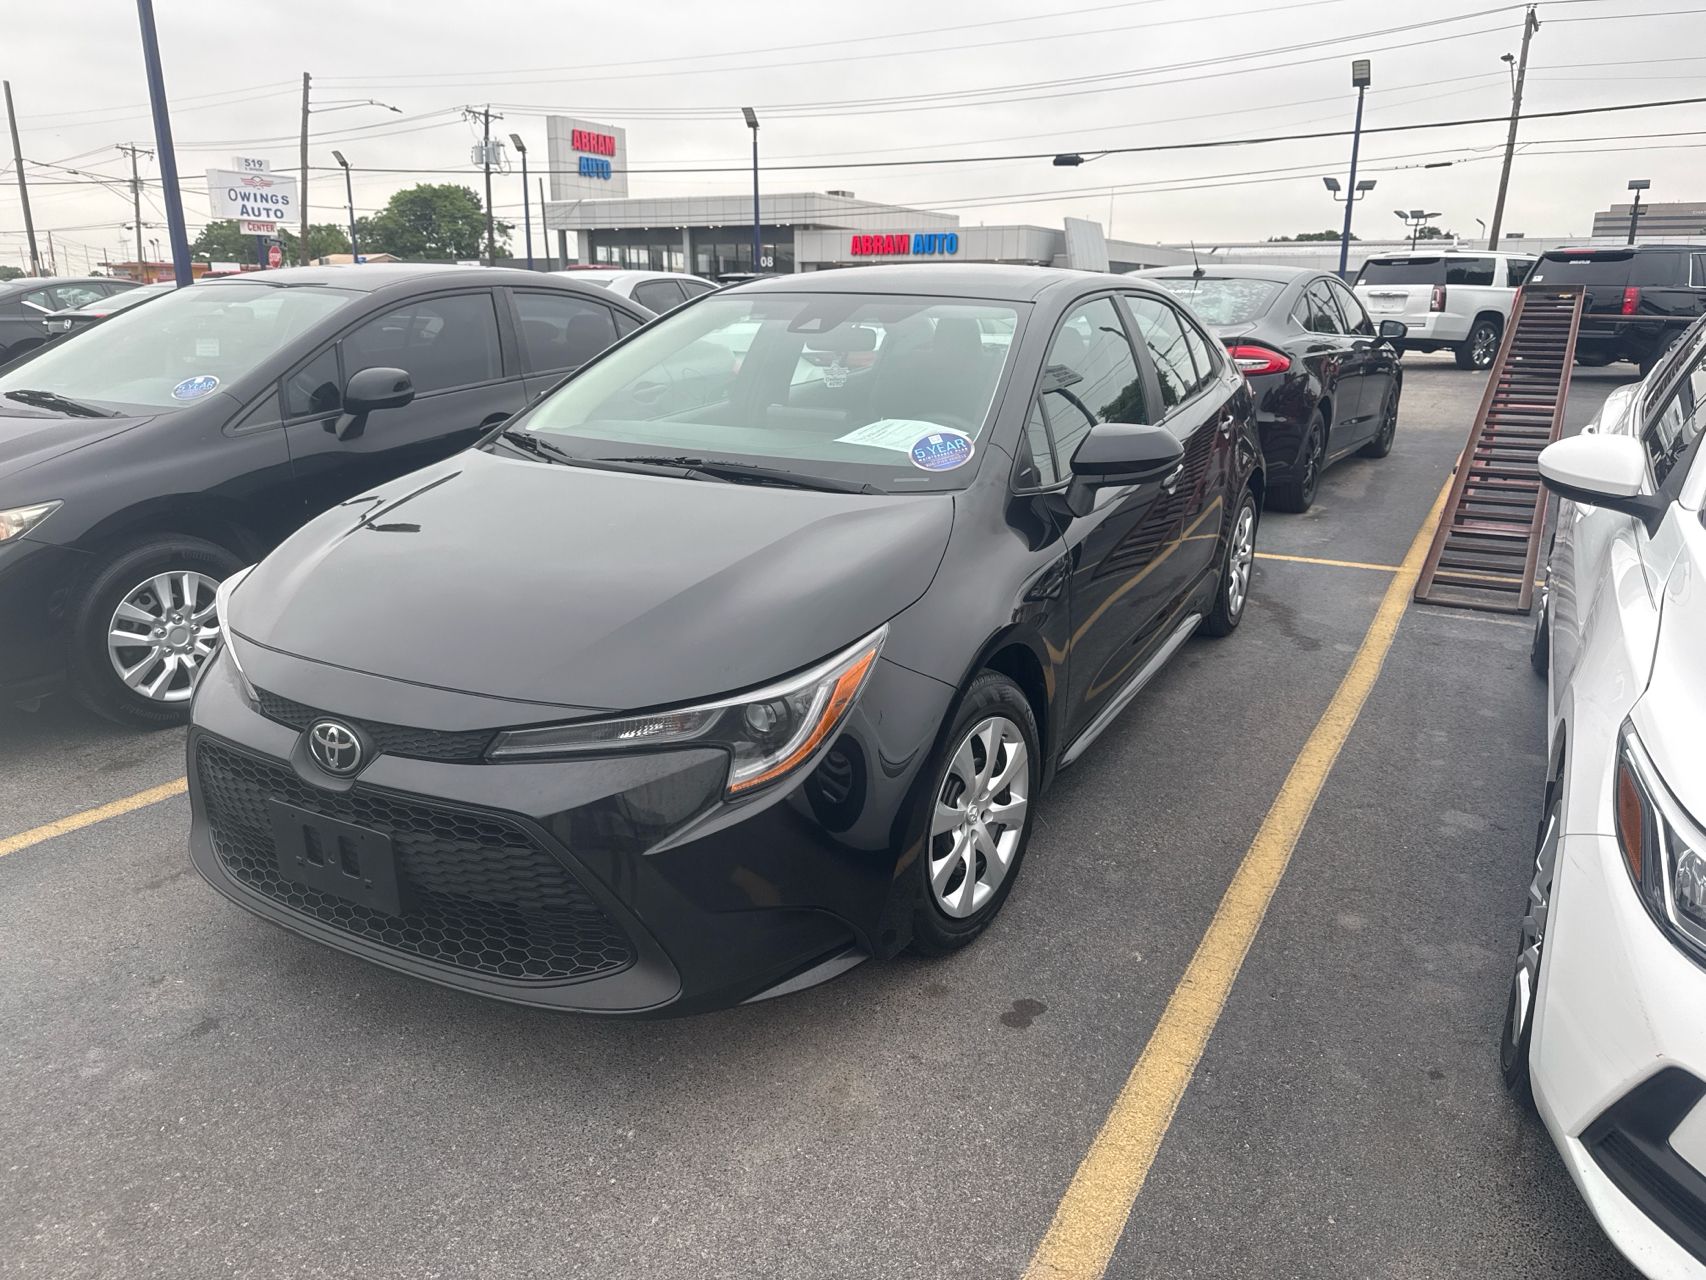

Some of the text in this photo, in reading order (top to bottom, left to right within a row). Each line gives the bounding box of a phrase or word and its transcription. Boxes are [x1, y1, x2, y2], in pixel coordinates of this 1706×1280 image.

[572, 128, 616, 157] ABRAM
[244, 158, 263, 168] 519
[579, 156, 612, 181] AUTO
[228, 188, 290, 205] OWINGS
[240, 204, 284, 219] AUTO
[247, 222, 275, 233] CENTER
[851, 232, 959, 256] ABRAM AUTO
[757, 256, 774, 267] 08
[914, 438, 966, 459] 5 YEAR
